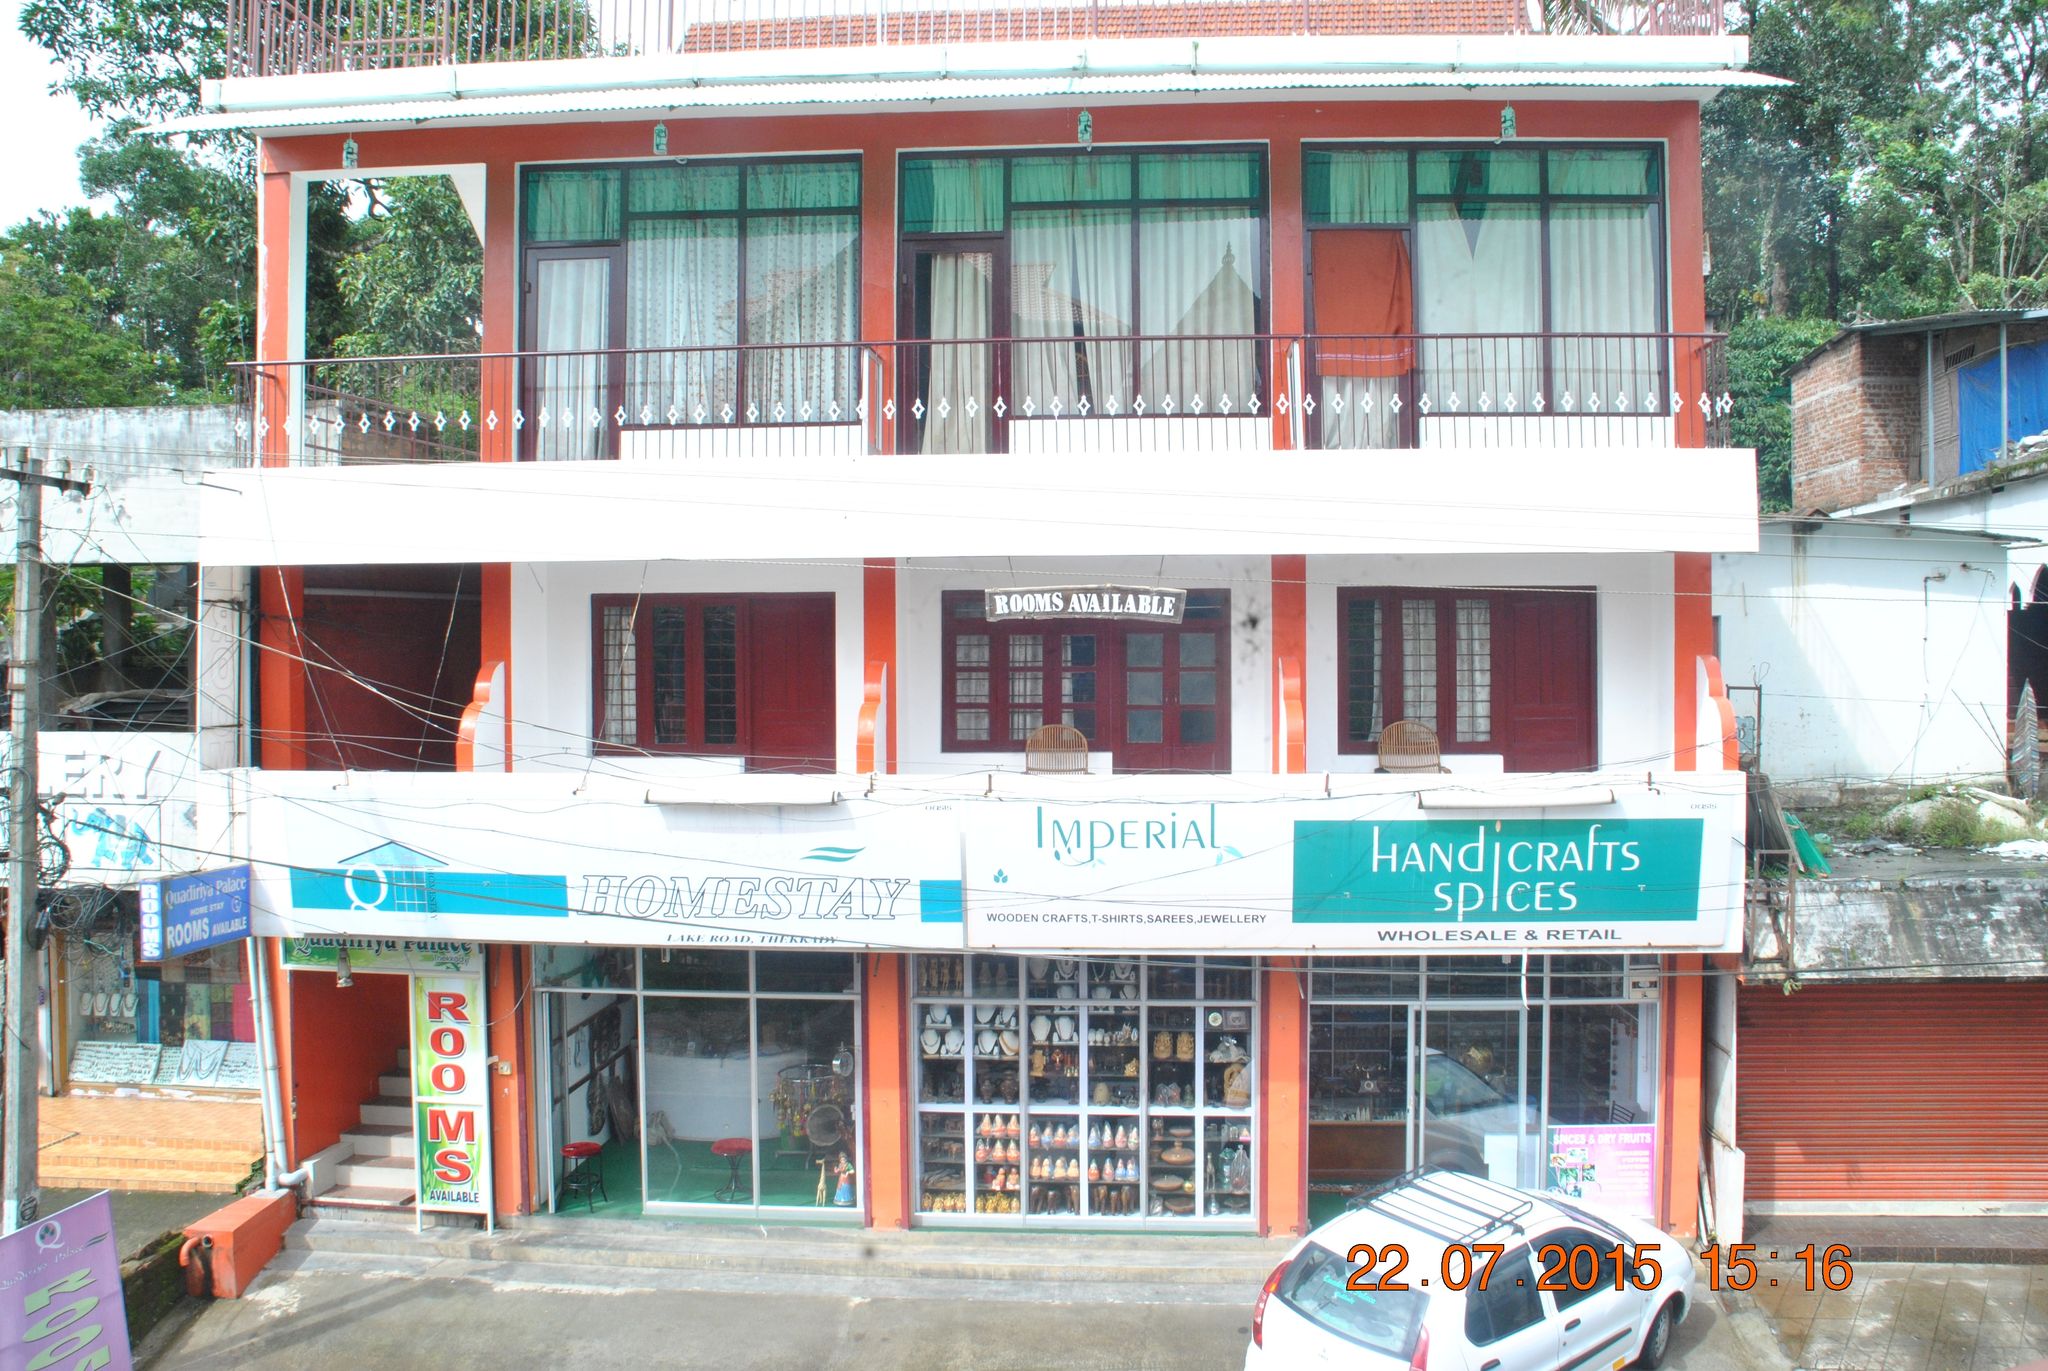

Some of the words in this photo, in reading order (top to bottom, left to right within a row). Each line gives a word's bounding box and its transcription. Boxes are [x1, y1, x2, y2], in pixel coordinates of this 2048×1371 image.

[993, 592, 1063, 615] ROOMS
[1067, 593, 1176, 617] AVAILABLE
[37, 749, 161, 799] ERY
[166, 883, 214, 909] Quadiriya
[215, 878, 247, 896] Palace
[577, 875, 911, 921] HOMESTAY
[1433, 878, 1578, 922] SPICES
[141, 884, 160, 957] ROOMS
[190, 905, 208, 916] HOME
[209, 901, 224, 912] STAY
[986, 913, 1039, 923] WOODEN
[167, 918, 209, 949] ROOMS
[212, 917, 247, 937] AVAILABLE
[667, 934, 705, 944] LAKE
[1377, 930, 1517, 941] WHOLESALE
[1524, 929, 1538, 941] &
[1546, 929, 1622, 941] RETAIL
[427, 991, 476, 1185] ROOMS
[1619, 1132, 1652, 1144] FRUITS
[429, 1188, 480, 1203] AVAILABLE
